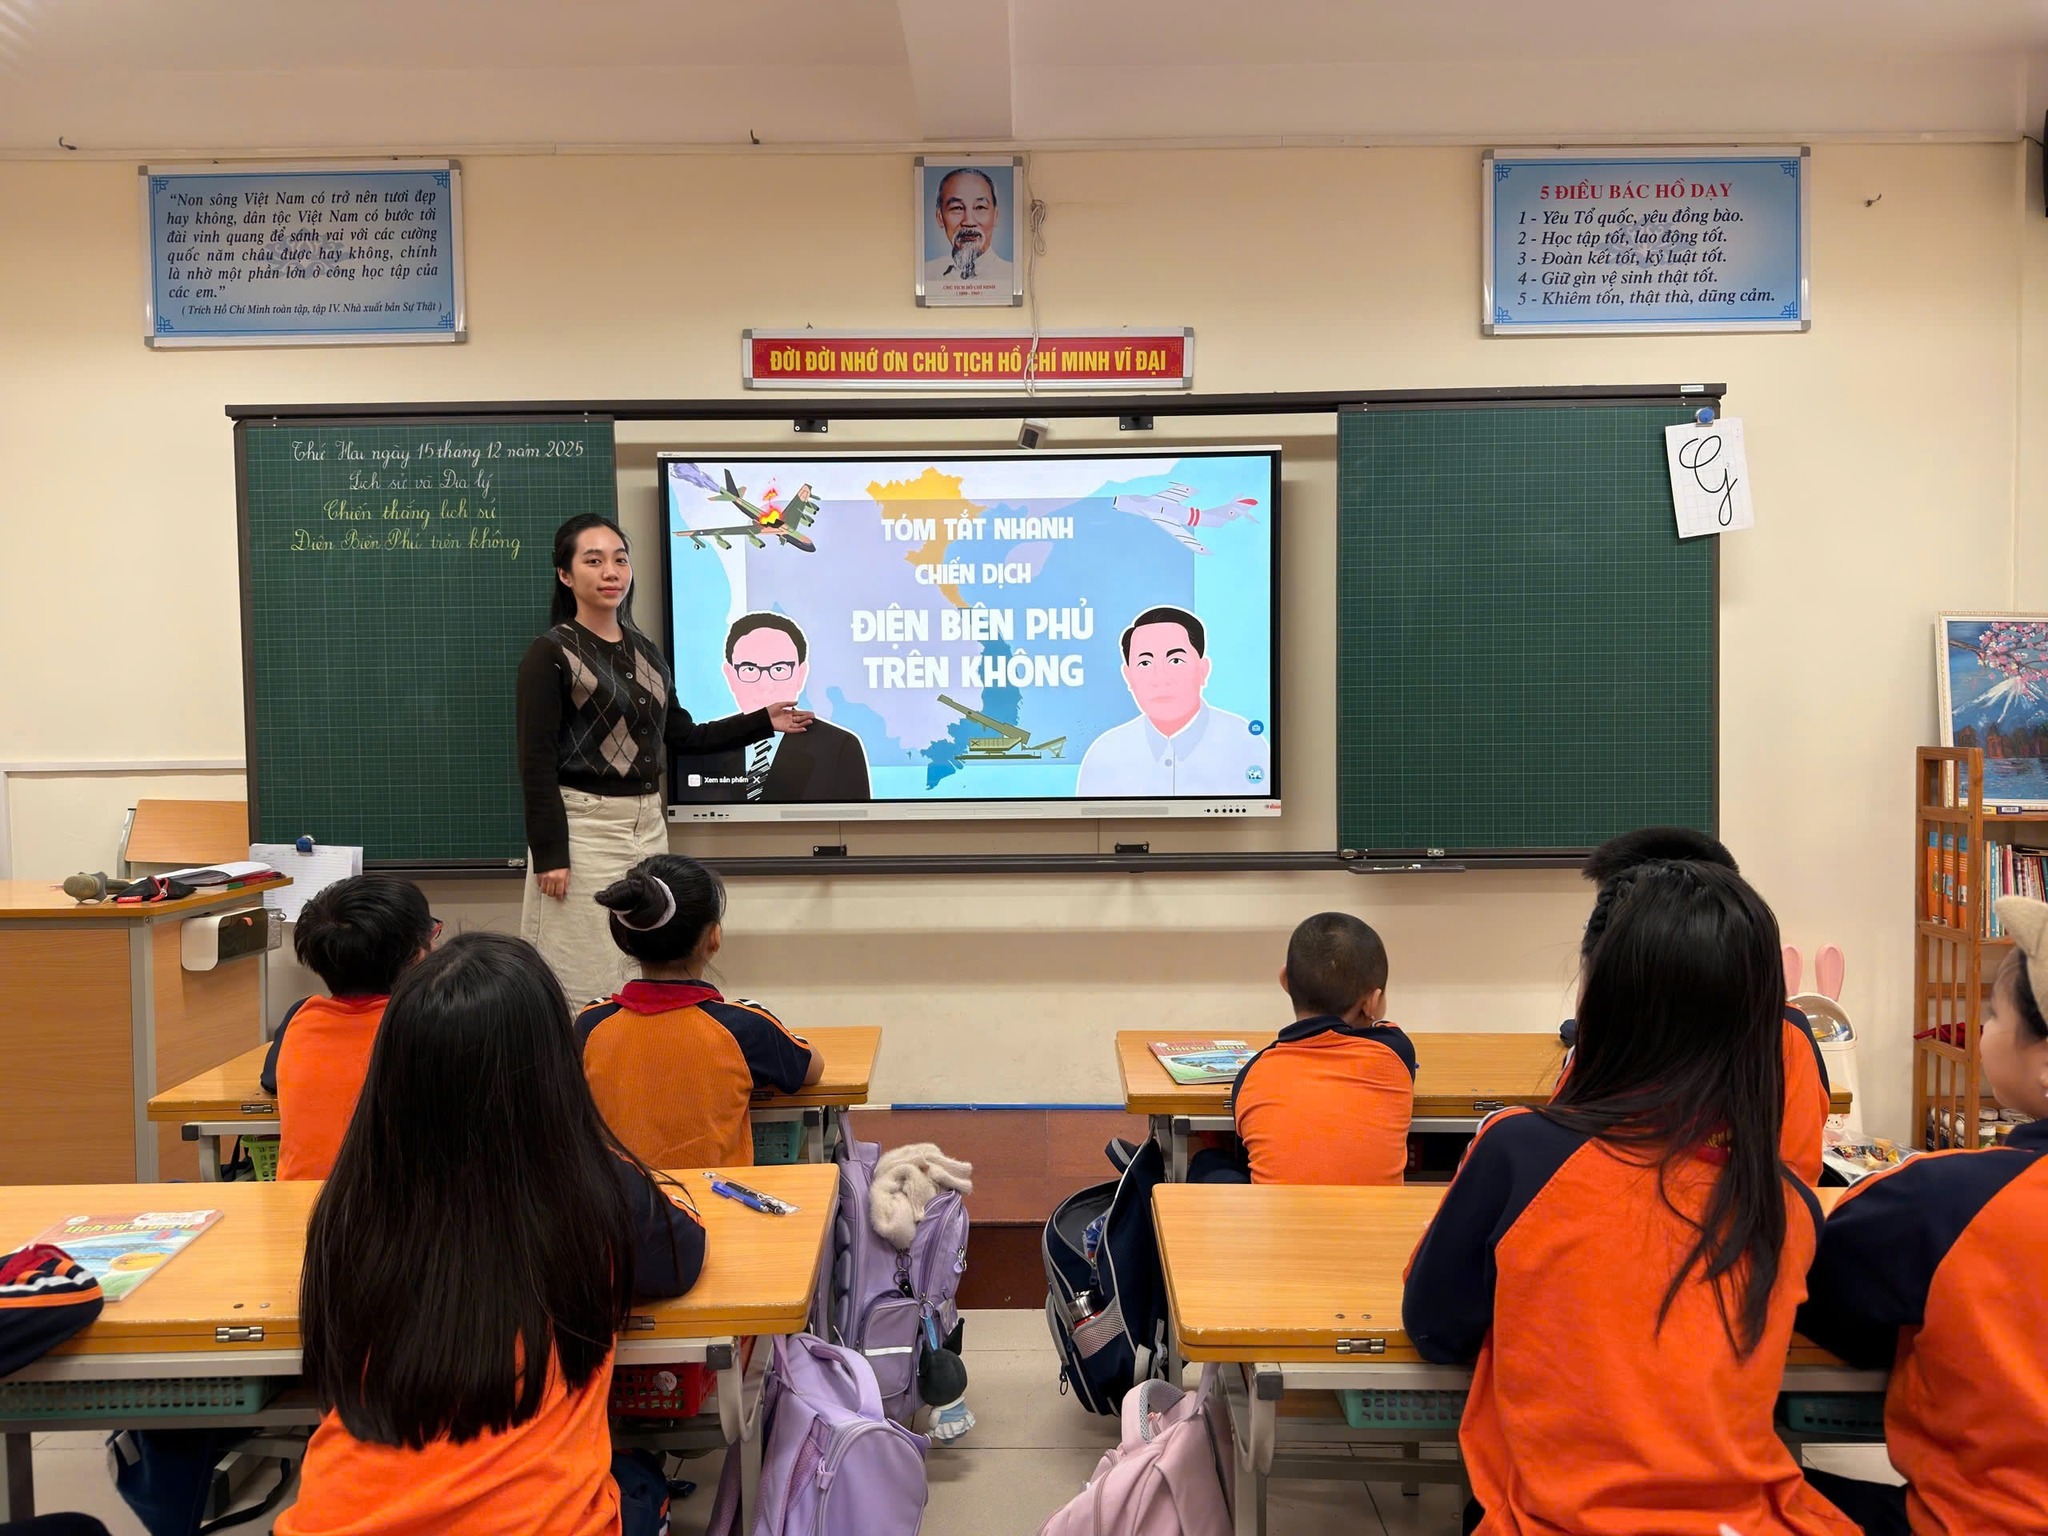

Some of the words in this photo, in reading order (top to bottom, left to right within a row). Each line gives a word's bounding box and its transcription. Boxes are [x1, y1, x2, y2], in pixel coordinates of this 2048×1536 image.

[209, 193, 238, 209] sông
[244, 192, 269, 207] Việt
[275, 191, 305, 206] Nam
[311, 191, 325, 205] có
[331, 189, 351, 204] trở
[355, 191, 378, 204] nên
[384, 190, 409, 204] tươi
[414, 189, 436, 205] đẹp
[1540, 185, 1550, 200] 5
[1554, 178, 1603, 200] ĐIỀU
[1609, 179, 1650, 199] BÁC
[1655, 178, 1686, 199] HỒ
[1691, 182, 1733, 201] DẠY
[166, 211, 189, 228] hay
[195, 211, 237, 228] không,
[243, 210, 266, 225] dân
[272, 210, 291, 227] tộc
[298, 209, 323, 225] Việt
[329, 210, 359, 223] Nam
[364, 208, 379, 223] có
[384, 207, 414, 222] bước
[420, 207, 436, 222] tới
[1518, 211, 1526, 225] 1
[1542, 210, 1569, 225] Yêu
[1574, 206, 1595, 225] Tổ
[1598, 208, 1637, 226] quốc,
[1641, 210, 1669, 227] yêu
[1672, 207, 1709, 225] đồng
[1713, 208, 1744, 223] bào.
[166, 229, 186, 244] đài
[193, 229, 220, 243] vinh
[226, 231, 264, 246] quang
[270, 226, 287, 243] để
[290, 228, 319, 242] sánh
[326, 228, 344, 242] vai
[350, 227, 368, 241] với
[374, 226, 394, 241] các
[400, 227, 437, 242] cường
[1517, 232, 1526, 246] 2
[1541, 231, 1571, 247] Học
[1576, 231, 1600, 248] tập
[1605, 228, 1630, 246] tốt,
[1634, 229, 1658, 245] lao
[1661, 228, 1698, 246] động
[1702, 227, 1727, 243] tốt.
[167, 246, 199, 265] quốc
[206, 248, 235, 262] năm
[241, 247, 274, 262] châu
[280, 247, 312, 263] được
[318, 246, 342, 263] hay
[348, 245, 394, 261] không,
[400, 245, 438, 259] chính
[1517, 252, 1526, 266] 3
[1541, 251, 1582, 266] Đoàn
[1587, 249, 1611, 265] kết
[1615, 248, 1641, 266] tốt,
[1645, 249, 1664, 266] kỷ
[1667, 249, 1697, 264] luật
[1702, 247, 1727, 263] tốt.
[168, 267, 180, 280] là
[186, 266, 213, 280] nhờ
[218, 267, 242, 282] một
[248, 265, 280, 283] phần
[286, 264, 306, 279] lớn
[312, 265, 321, 278] ở
[326, 265, 356, 282] công
[361, 264, 384, 280] học
[390, 264, 410, 280] tập
[416, 263, 438, 277] của
[1517, 272, 1527, 286] 4
[1542, 271, 1571, 285] Giữ
[1573, 271, 1596, 288] gìn
[1602, 271, 1617, 286] vệ
[1621, 270, 1653, 284] sinh
[1657, 269, 1689, 284] thật
[1693, 267, 1718, 283] tốt.
[169, 285, 190, 299] các
[1517, 291, 1527, 306] 5
[1542, 290, 1591, 306] Khiêm
[1596, 288, 1625, 306] tốn,
[1629, 289, 1661, 305] thật
[1665, 289, 1694, 306] thà,
[1698, 289, 1736, 304] dũng
[1740, 287, 1776, 303] cảm.
[187, 303, 212, 315] Trích
[213, 302, 228, 315] Hồ
[229, 303, 245, 315] Chí
[247, 303, 270, 315] Minh
[272, 303, 292, 315] toàn
[294, 303, 310, 317] tập,
[312, 303, 327, 316] tập
[342, 302, 362, 314] Nhà
[363, 301, 383, 314] xuất
[384, 302, 401, 313] bản
[402, 301, 414, 315] Sự
[416, 301, 436, 314] Thật
[770, 347, 801, 372] ĐỜI
[805, 347, 836, 372] ĐỜI
[840, 347, 879, 372] NHỚ
[882, 349, 908, 372] ƠN
[913, 344, 949, 373] CHỦ
[953, 350, 994, 378] TỊCH
[997, 344, 1022, 373] HỒ
[1028, 346, 1057, 372] CHÍ
[1061, 350, 1110, 372] MINH
[1113, 345, 1133, 372] VĨ
[1135, 349, 1167, 376] ĐẠI
[292, 440, 326, 461] Thứ
[335, 440, 365, 461] Hai
[372, 444, 410, 469] ngày
[418, 442, 436, 460] 15
[438, 439, 482, 468] tháng
[486, 441, 502, 459] 12
[507, 443, 541, 458] năm
[545, 440, 584, 458] 2025
[415, 475, 433, 489] và
[474, 468, 494, 499] lý
[323, 498, 372, 521] Chiến
[382, 499, 430, 530] thắng
[881, 514, 936, 541] TÓM
[944, 509, 986, 541] TẮT
[994, 516, 1074, 540] NHANH
[340, 528, 381, 551] Biên
[431, 533, 461, 549] trên
[468, 527, 520, 560] không
[915, 556, 975, 585] CHIẾN
[982, 562, 1031, 589] DỊCH
[850, 602, 929, 650] ĐIỆN
[941, 601, 1014, 641] BIÊN
[1026, 597, 1094, 641] PHỦ
[863, 649, 949, 689] TRÊN
[961, 648, 1084, 688] KHÔNG
[731, 776, 749, 784] phẩm
